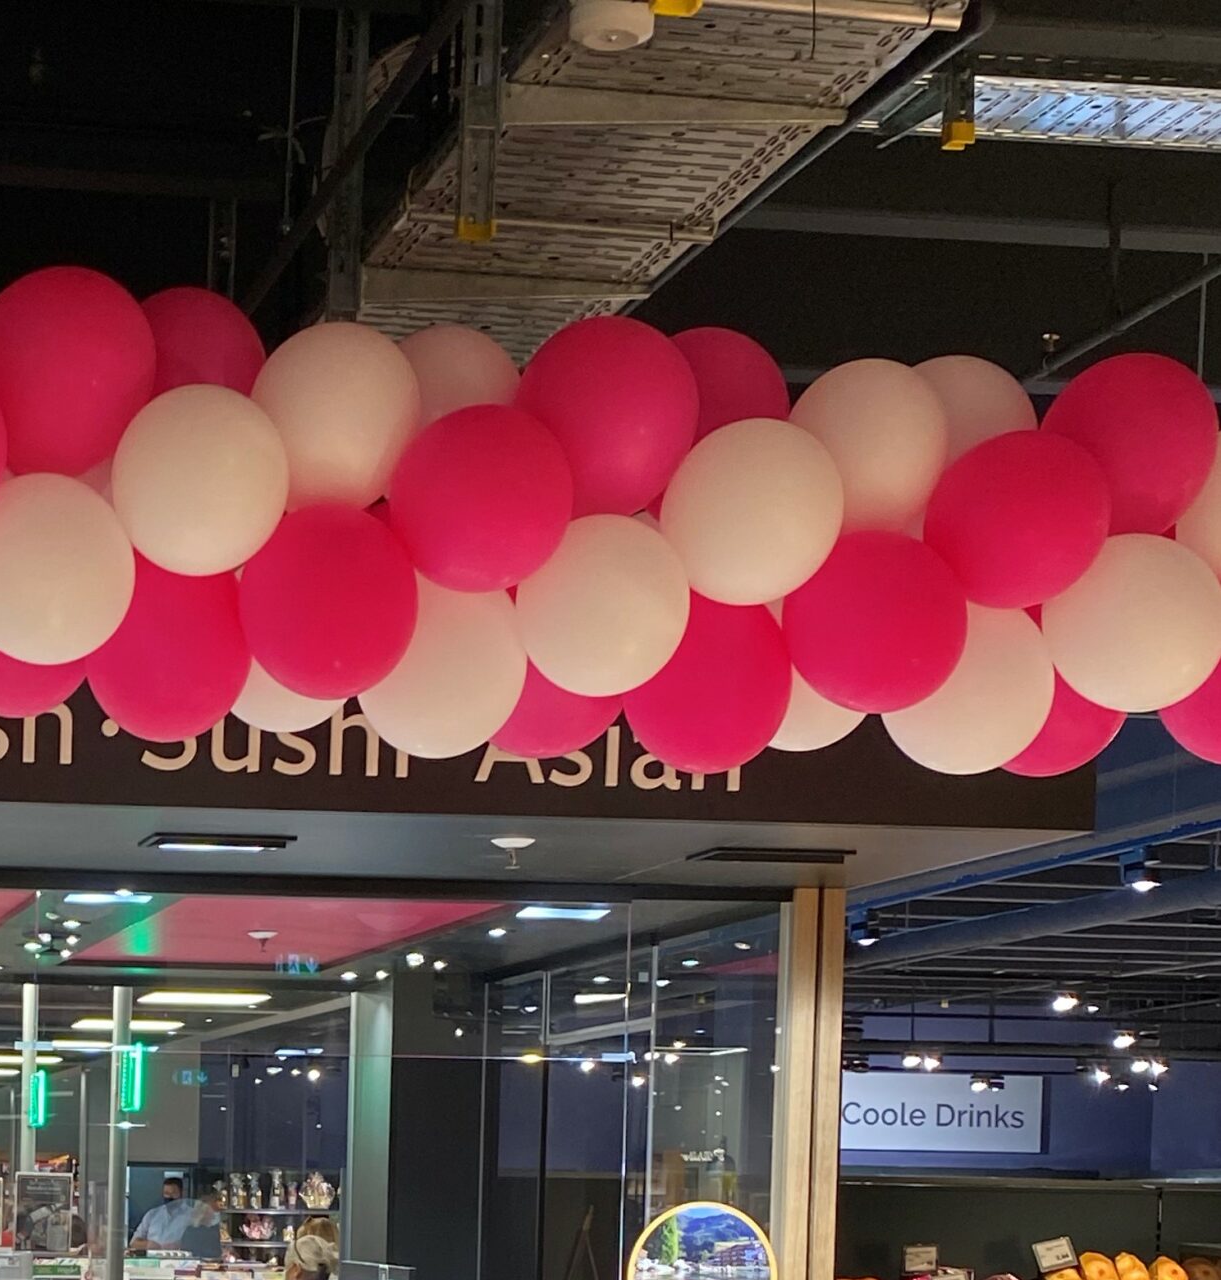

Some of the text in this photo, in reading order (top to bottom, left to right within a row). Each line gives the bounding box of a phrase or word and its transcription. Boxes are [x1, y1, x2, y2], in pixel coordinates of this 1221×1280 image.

[141, 700, 409, 777] ush
[842, 1102, 1025, 1129] Coole Drinks
